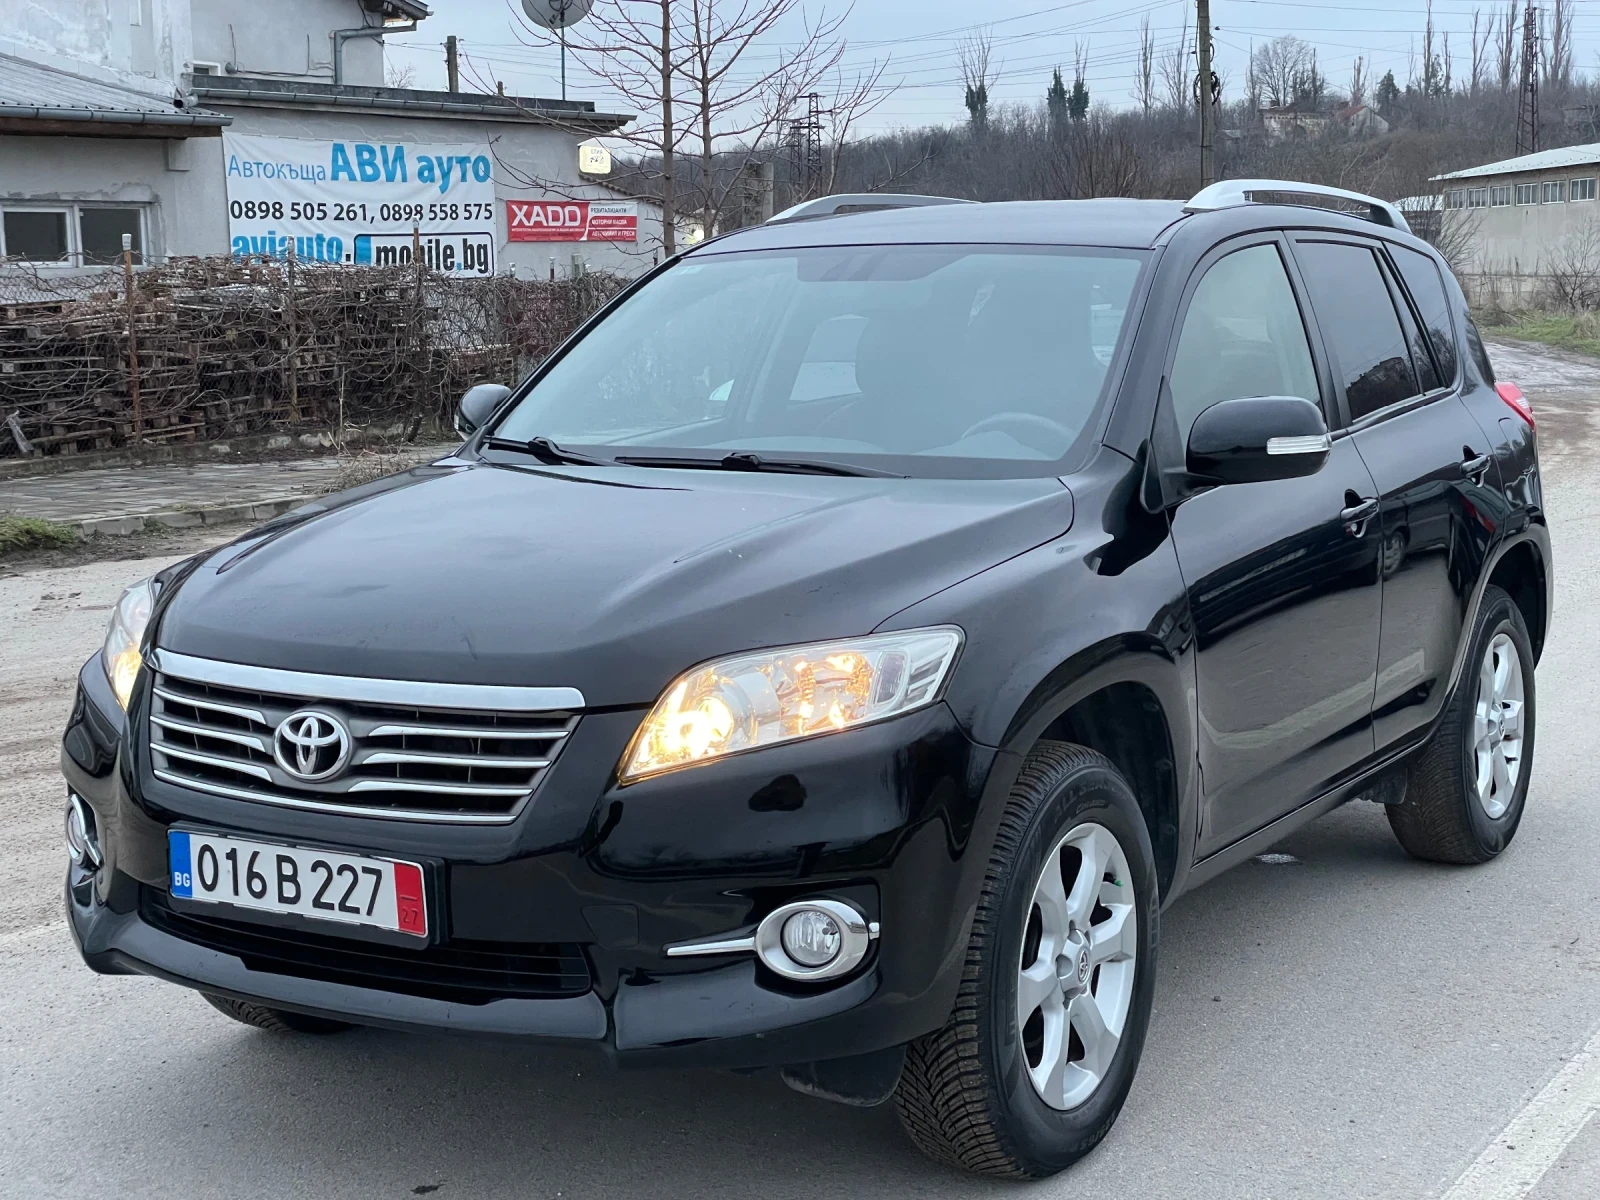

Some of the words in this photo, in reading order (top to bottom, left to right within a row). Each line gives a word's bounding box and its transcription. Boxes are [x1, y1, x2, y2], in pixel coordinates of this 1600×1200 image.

[228, 154, 326, 185] Автокъща
[330, 143, 408, 183] АВИ
[416, 154, 491, 195] ауто
[230, 200, 284, 220] 0898
[290, 202, 328, 220] 505
[333, 203, 375, 224] 261,
[380, 203, 424, 221] 0898
[428, 203, 459, 220] 558
[463, 203, 493, 220] 575
[174, 872, 191, 887] BG
[402, 906, 419, 926] 27
